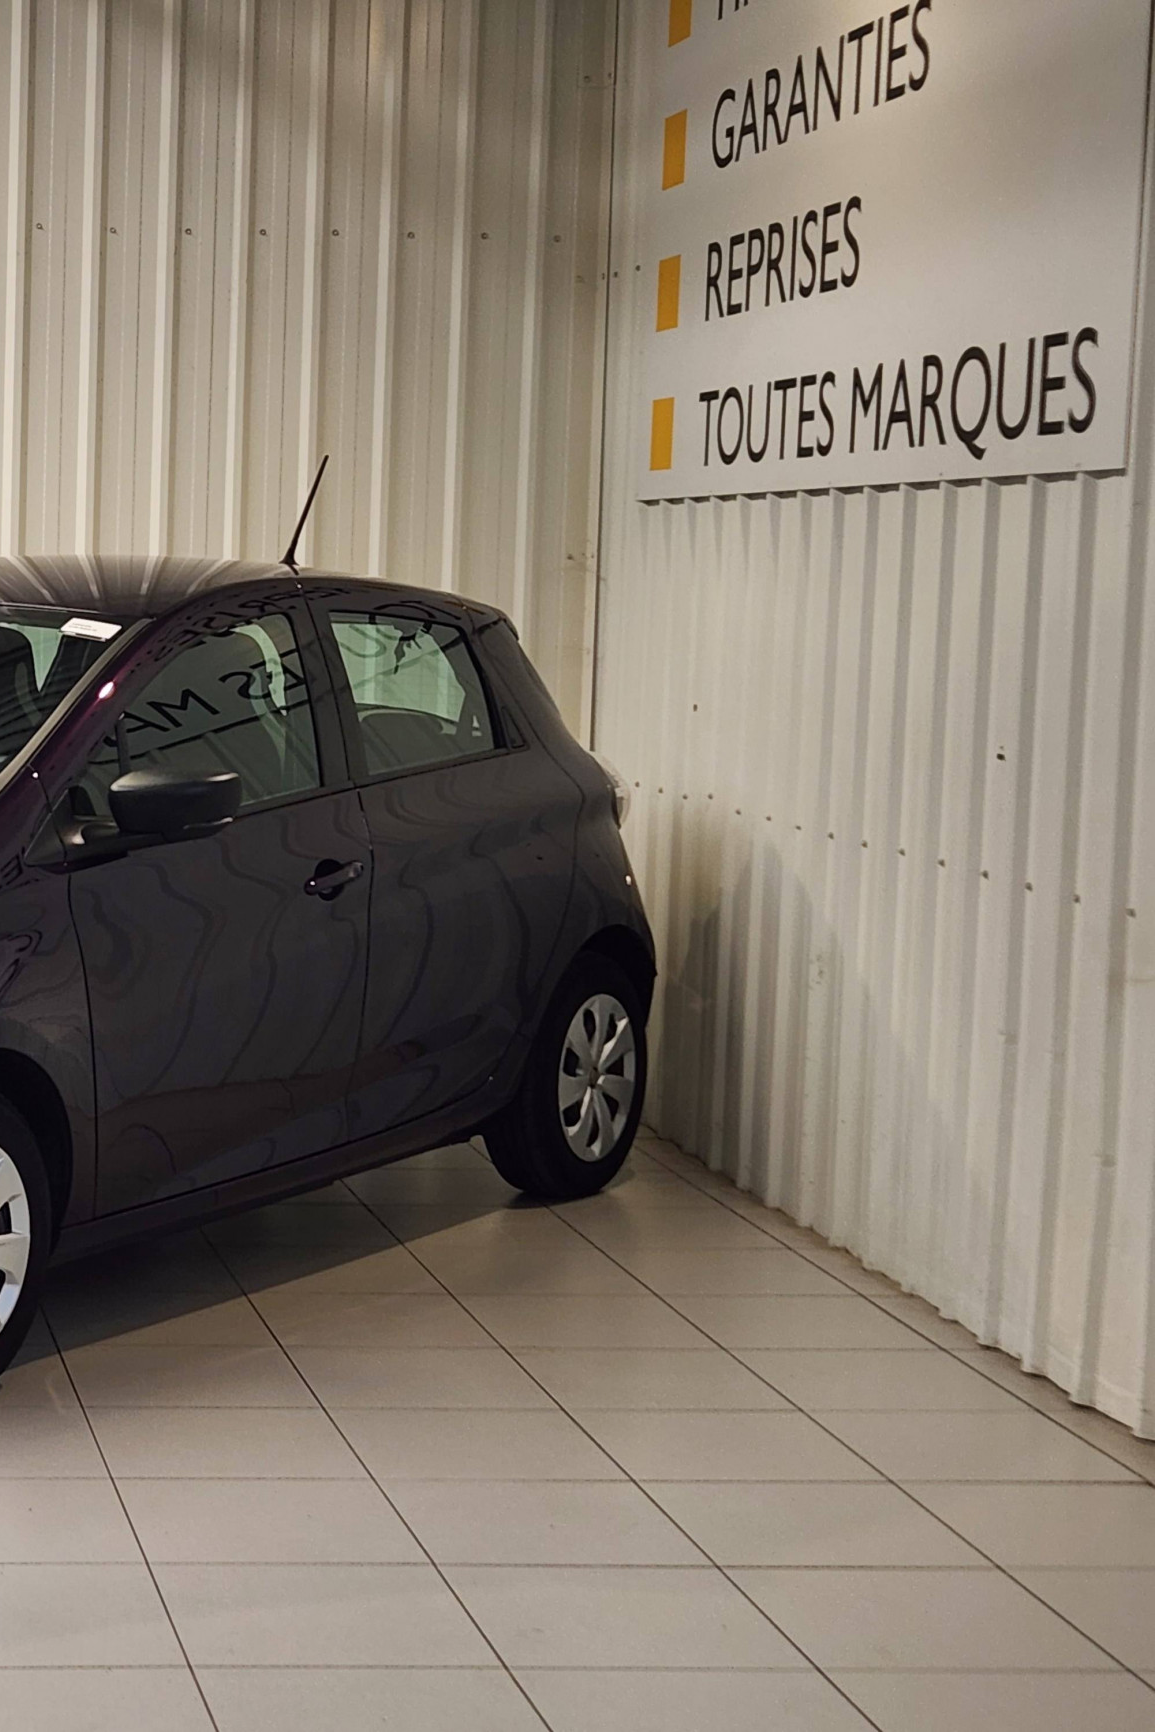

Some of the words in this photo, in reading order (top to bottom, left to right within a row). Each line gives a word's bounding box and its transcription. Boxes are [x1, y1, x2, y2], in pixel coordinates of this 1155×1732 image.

[712, 0, 932, 168] GARANTIES
[705, 196, 862, 322] REPRISES
[699, 371, 836, 466] TOUTES
[849, 327, 1098, 461] MARQUES
